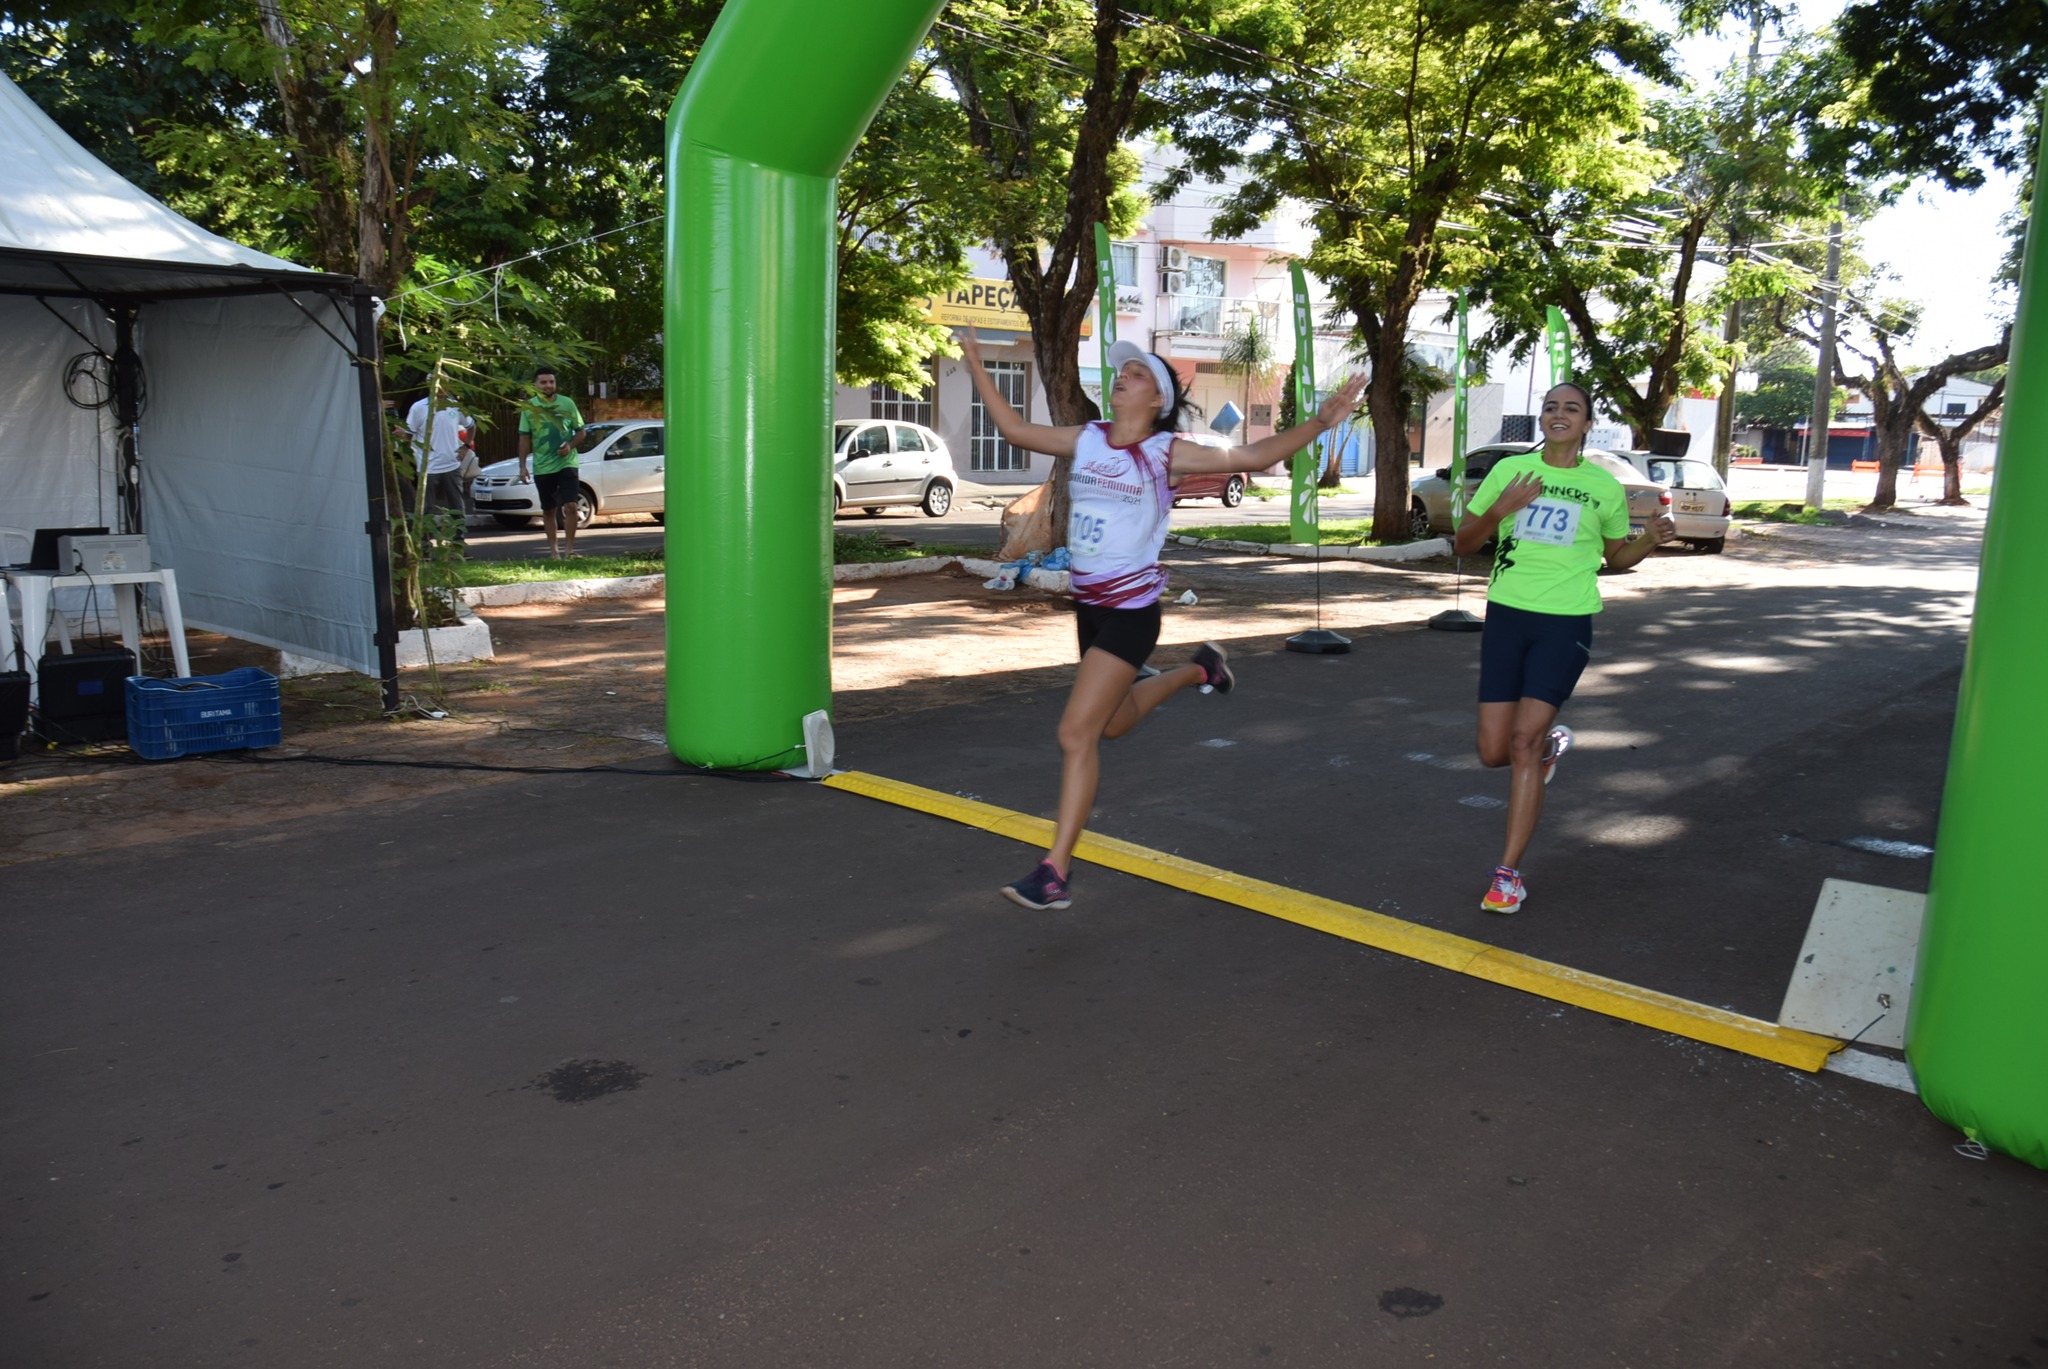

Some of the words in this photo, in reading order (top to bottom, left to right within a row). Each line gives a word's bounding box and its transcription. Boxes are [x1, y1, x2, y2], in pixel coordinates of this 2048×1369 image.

[946, 284, 1020, 313] TAPEÇA
[1072, 512, 1106, 543] 705
[1526, 504, 1569, 532] 773
[200, 709, 232, 718] BURITAMA
